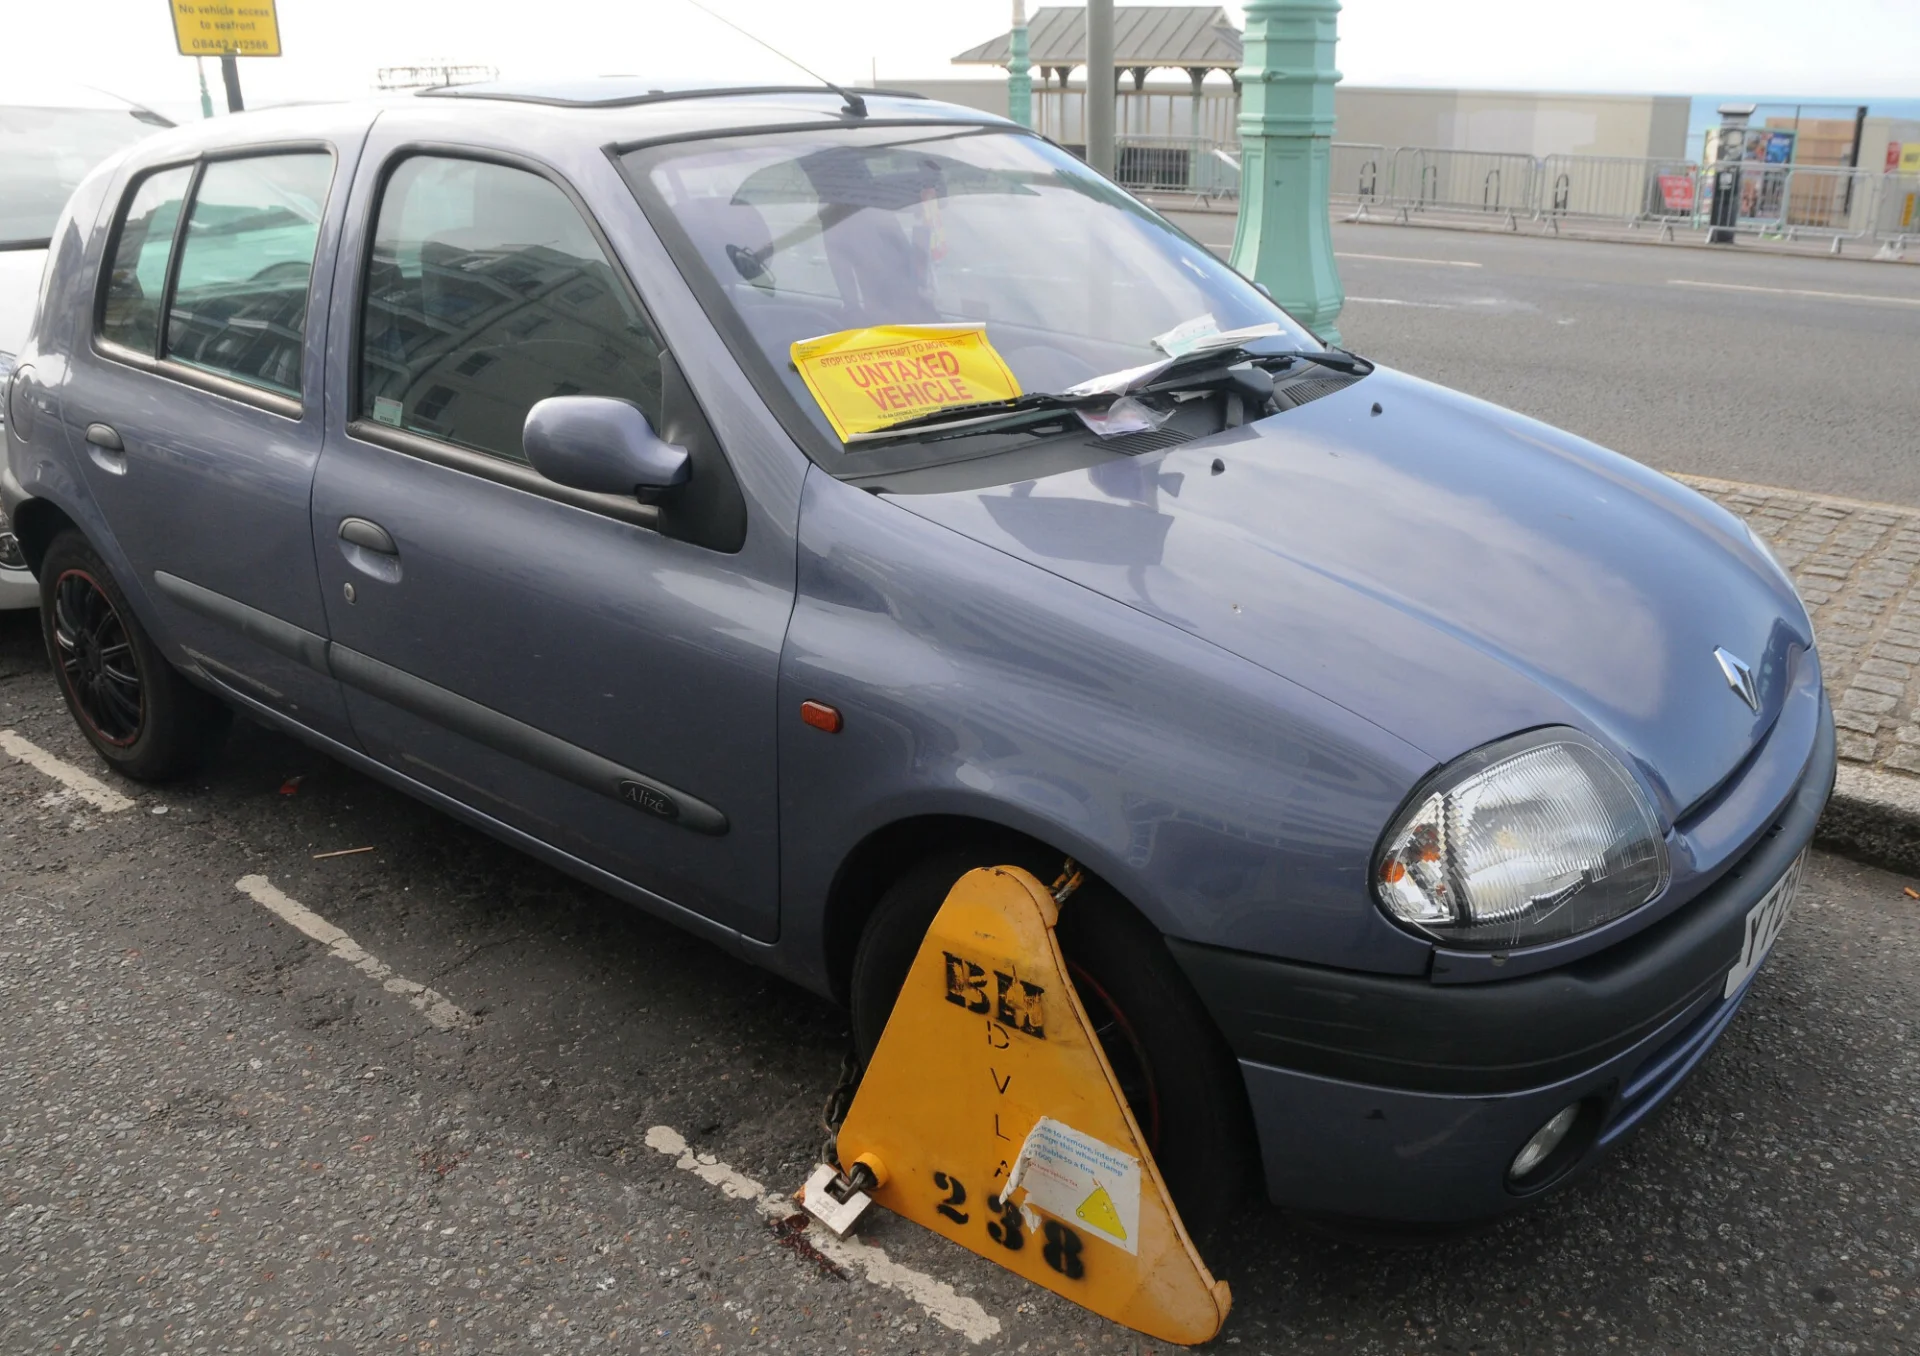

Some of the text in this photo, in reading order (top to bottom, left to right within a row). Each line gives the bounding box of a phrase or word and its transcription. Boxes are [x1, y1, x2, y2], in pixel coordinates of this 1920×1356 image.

[178, 4, 270, 17] No vehicle access
[200, 20, 256, 31] to seafront
[820, 356, 844, 368] STOP!
[845, 355, 858, 364] DO
[859, 352, 873, 362] NOT
[876, 348, 911, 360] ATTEMPT
[912, 343, 924, 353] TO
[925, 340, 948, 350] MOVE
[845, 350, 960, 388] UNTAXED
[865, 378, 974, 411] VEHICLE
[626, 787, 664, 812] Alizé
[1060, 1140, 1074, 1153] this
[1075, 1148, 1098, 1164] wheel
[1099, 1160, 1123, 1177] clamp
[1080, 1162, 1095, 1176] fine
[1094, 1149, 1129, 1170] interfere
[933, 1170, 1085, 1281] 238
